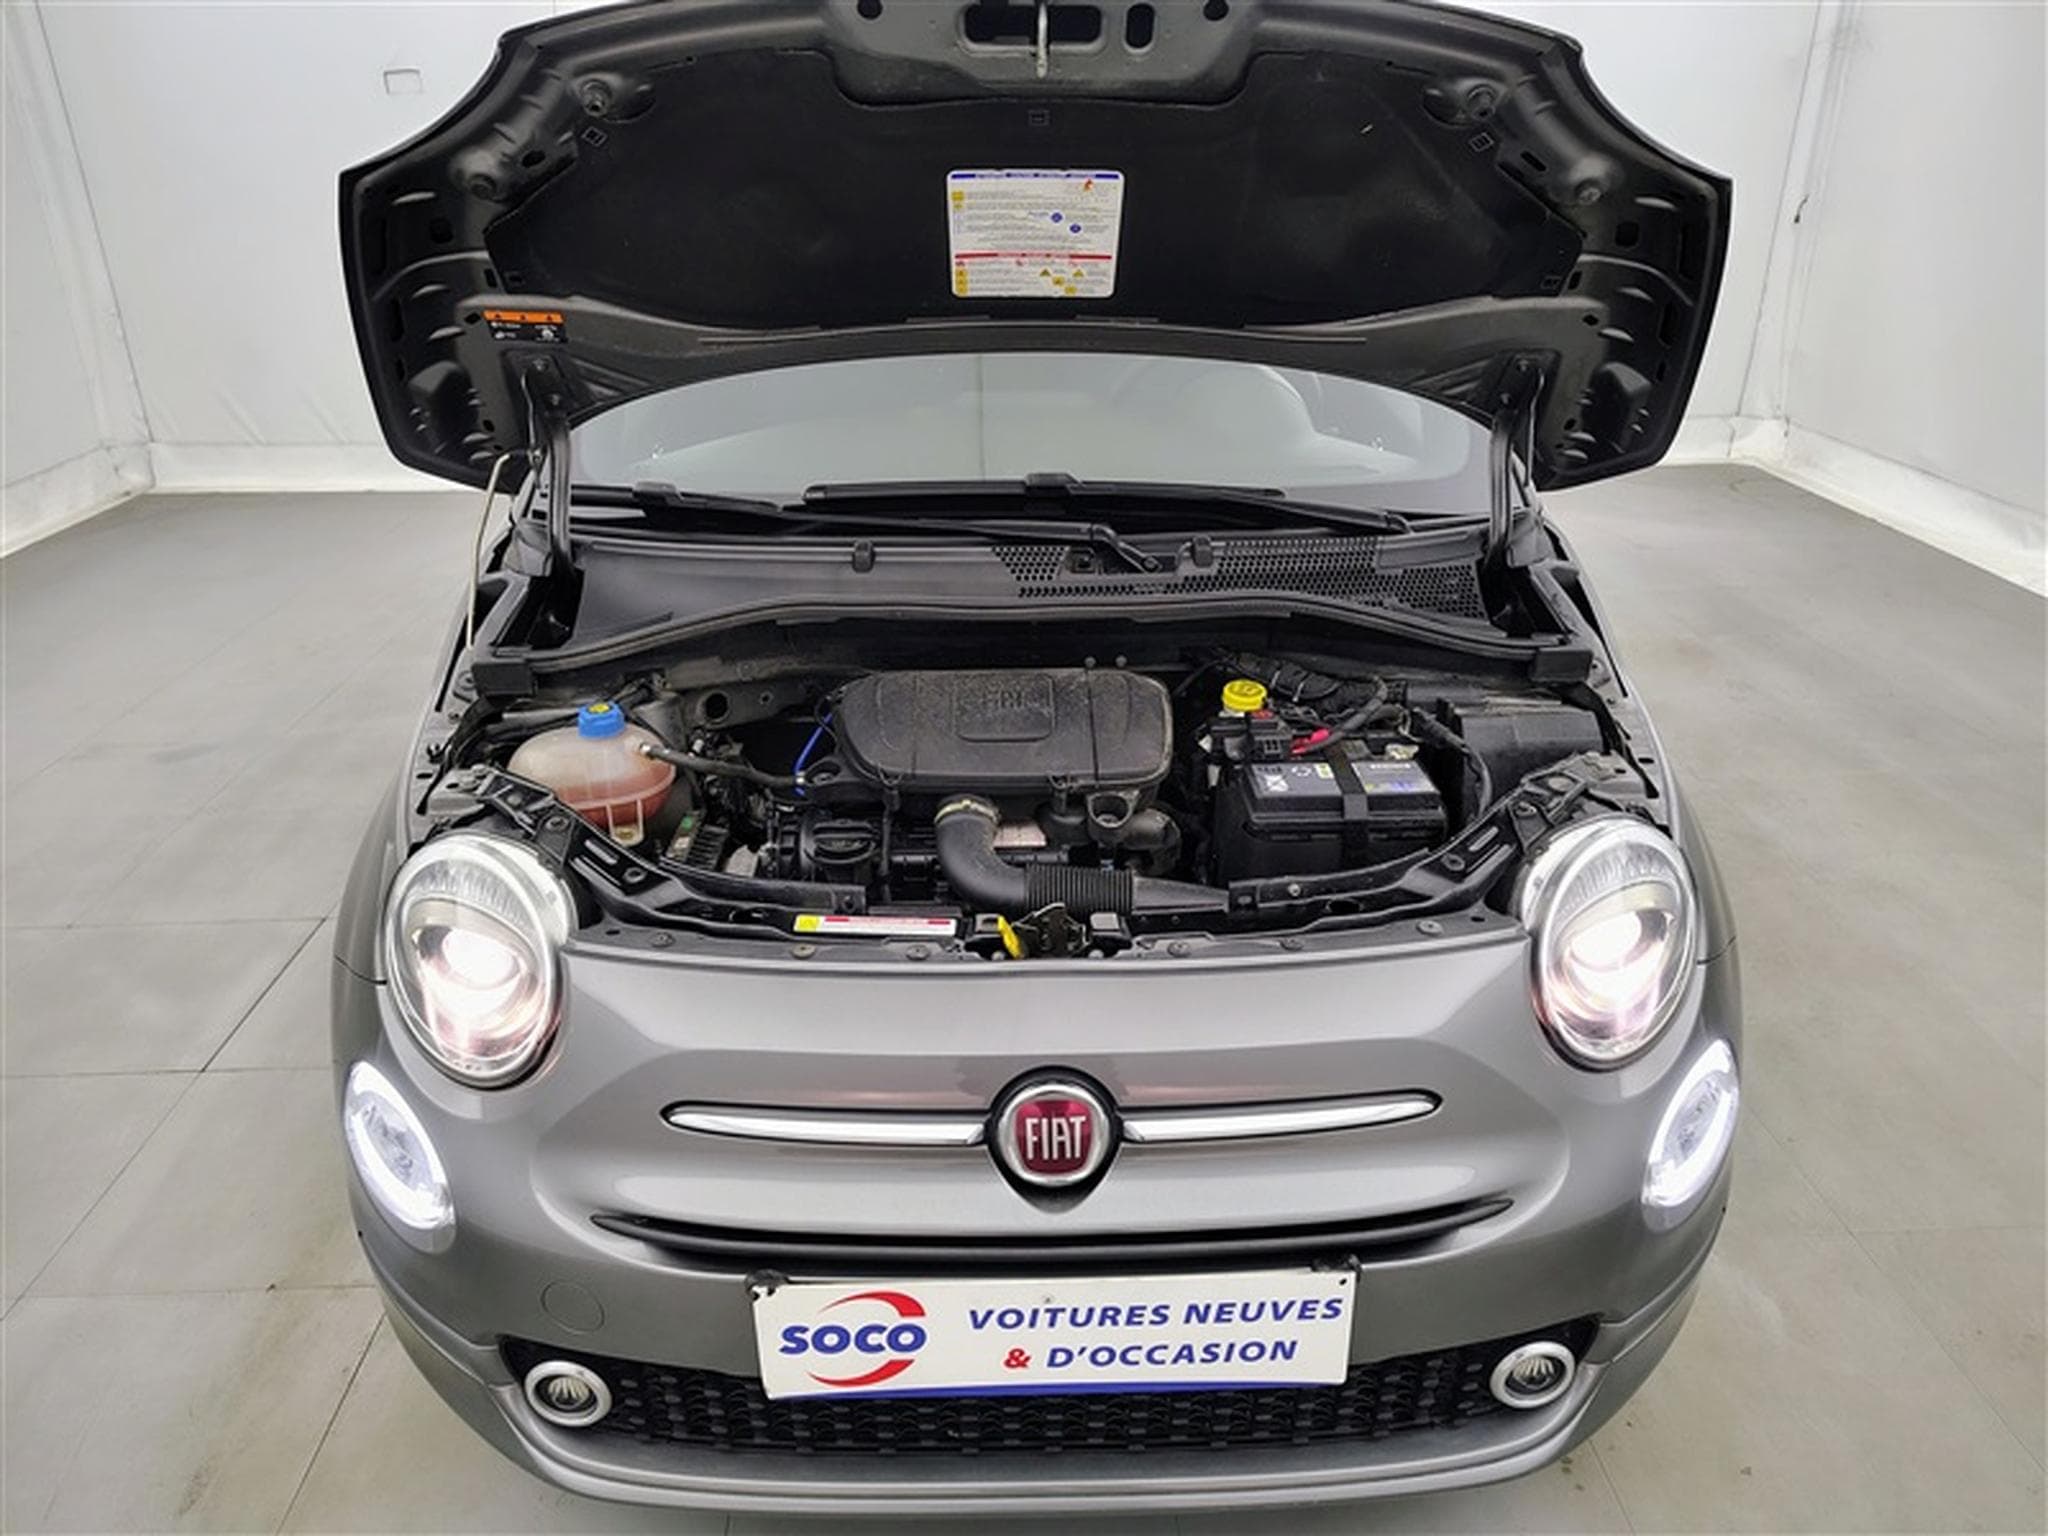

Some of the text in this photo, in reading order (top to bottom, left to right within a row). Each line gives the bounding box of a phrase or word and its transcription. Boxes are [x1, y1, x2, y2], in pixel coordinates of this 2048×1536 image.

[1025, 1115, 1087, 1161] FIAT
[970, 1298, 1343, 1330] VOITURES NEUVES
[779, 1322, 927, 1355] SOCO
[1003, 1340, 1298, 1369] & D'OCCASION
